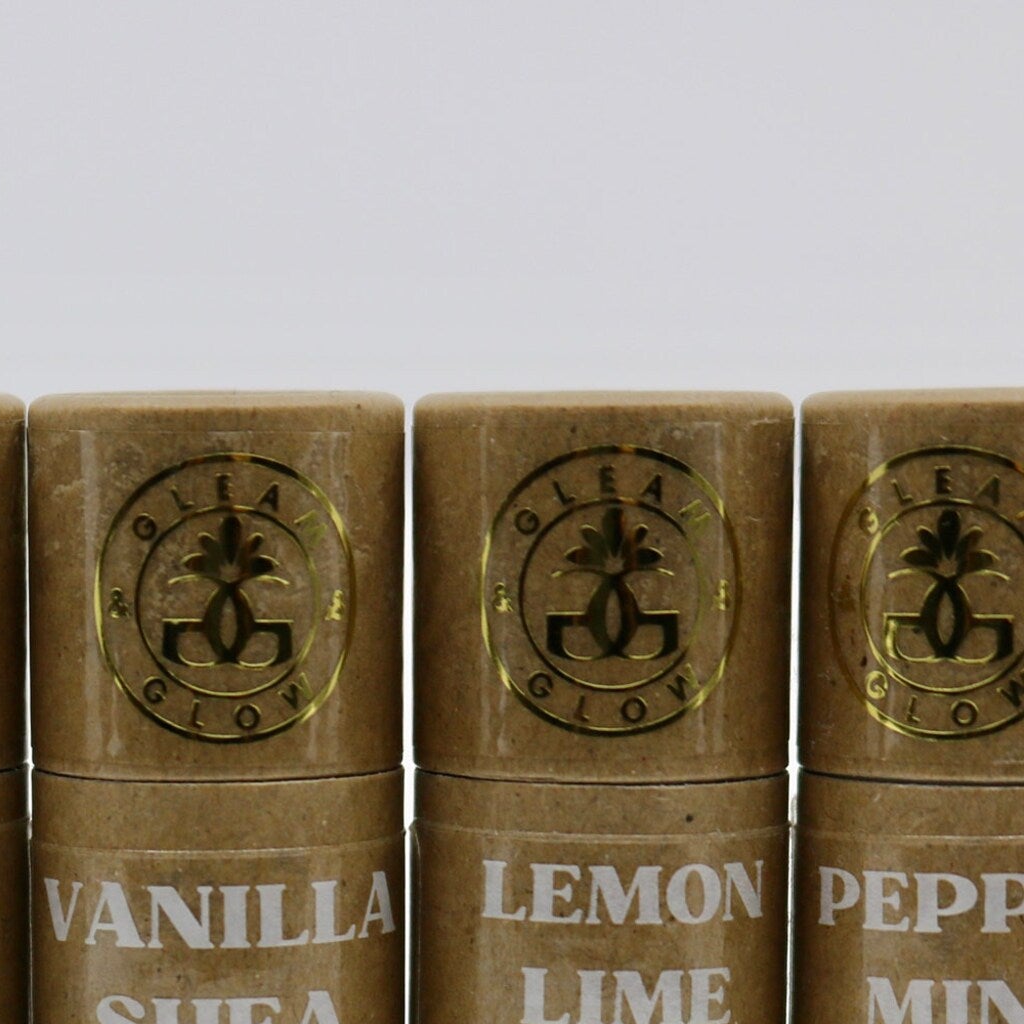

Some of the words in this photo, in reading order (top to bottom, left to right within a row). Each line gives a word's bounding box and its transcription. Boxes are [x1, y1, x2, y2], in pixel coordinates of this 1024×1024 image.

[132, 473, 328, 548] GLEAM
[514, 464, 711, 536] GLEAM
[142, 672, 314, 729] GLOW
[527, 663, 702, 724] GLOW
[43, 872, 396, 950] VANILLA
[482, 860, 765, 925] LEMON
